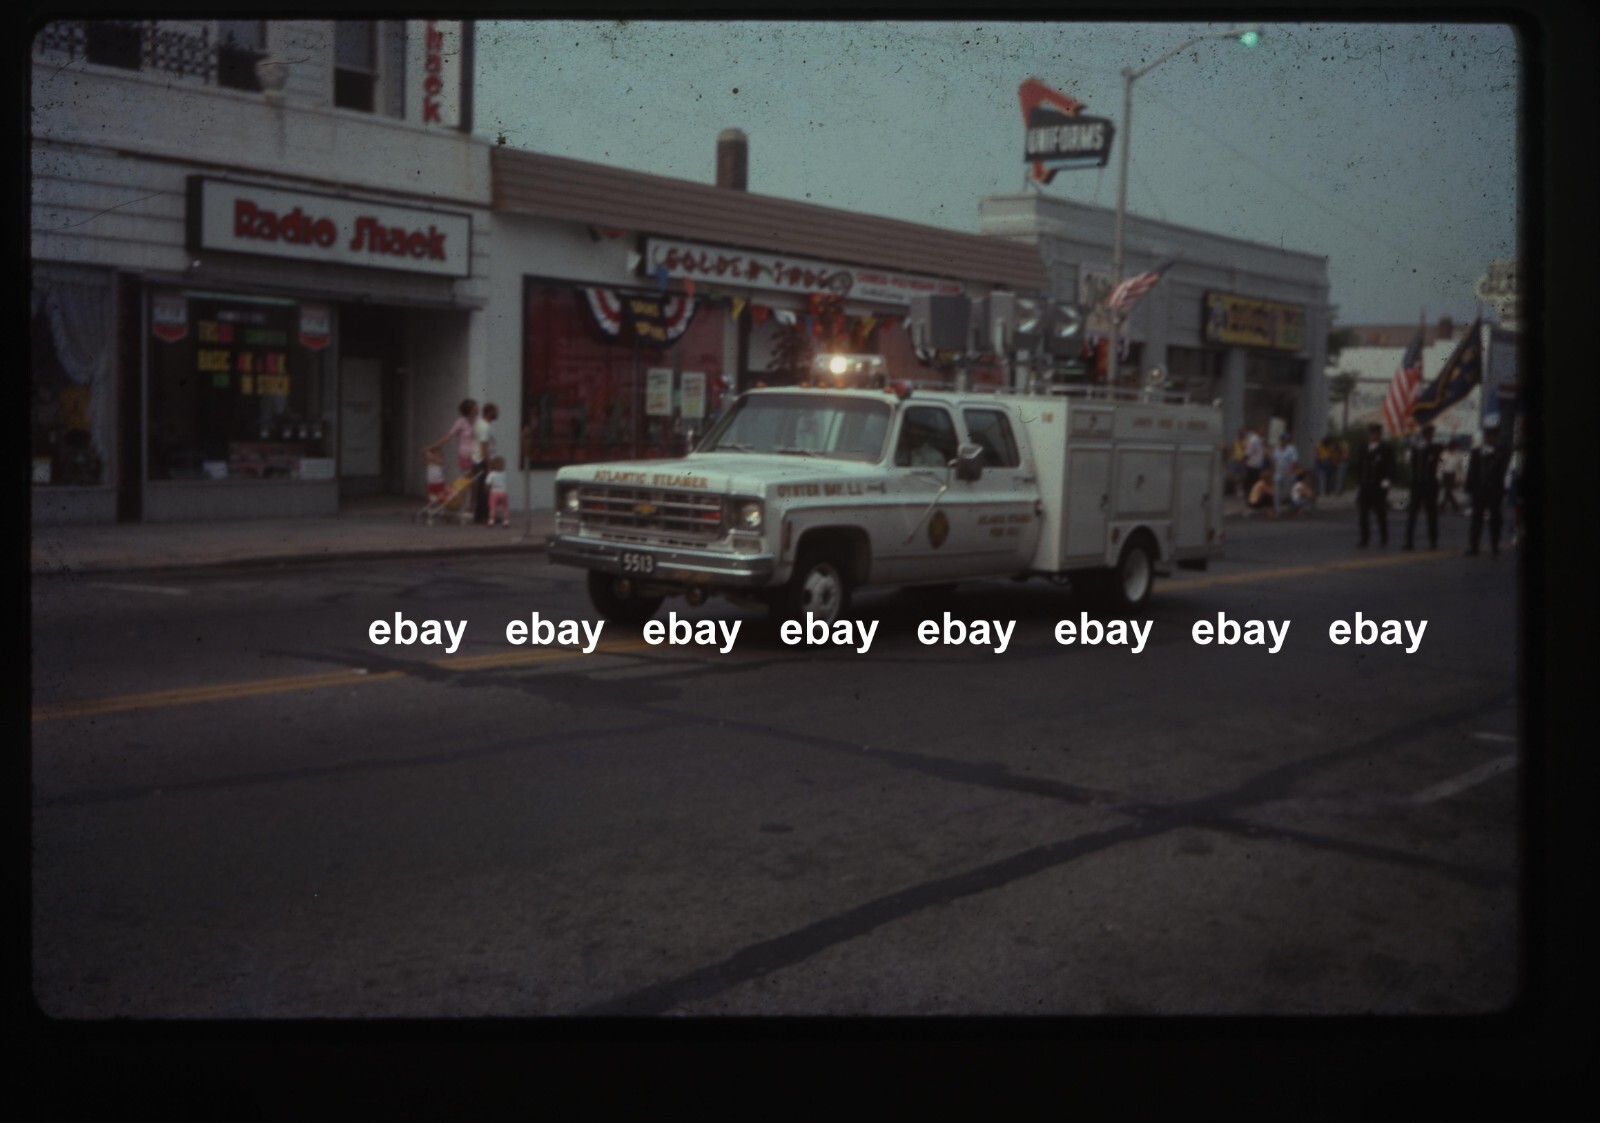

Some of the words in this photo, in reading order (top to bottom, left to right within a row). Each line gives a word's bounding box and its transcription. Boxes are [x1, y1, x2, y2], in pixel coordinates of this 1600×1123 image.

[1027, 122, 1105, 154] UNIFORMS
[234, 199, 336, 247] Radio
[349, 215, 447, 261] Shack
[594, 470, 646, 485] ATLANTIC
[653, 474, 708, 489] STEAMER
[777, 482, 820, 498] OYSTER
[623, 552, 653, 574] 5513
